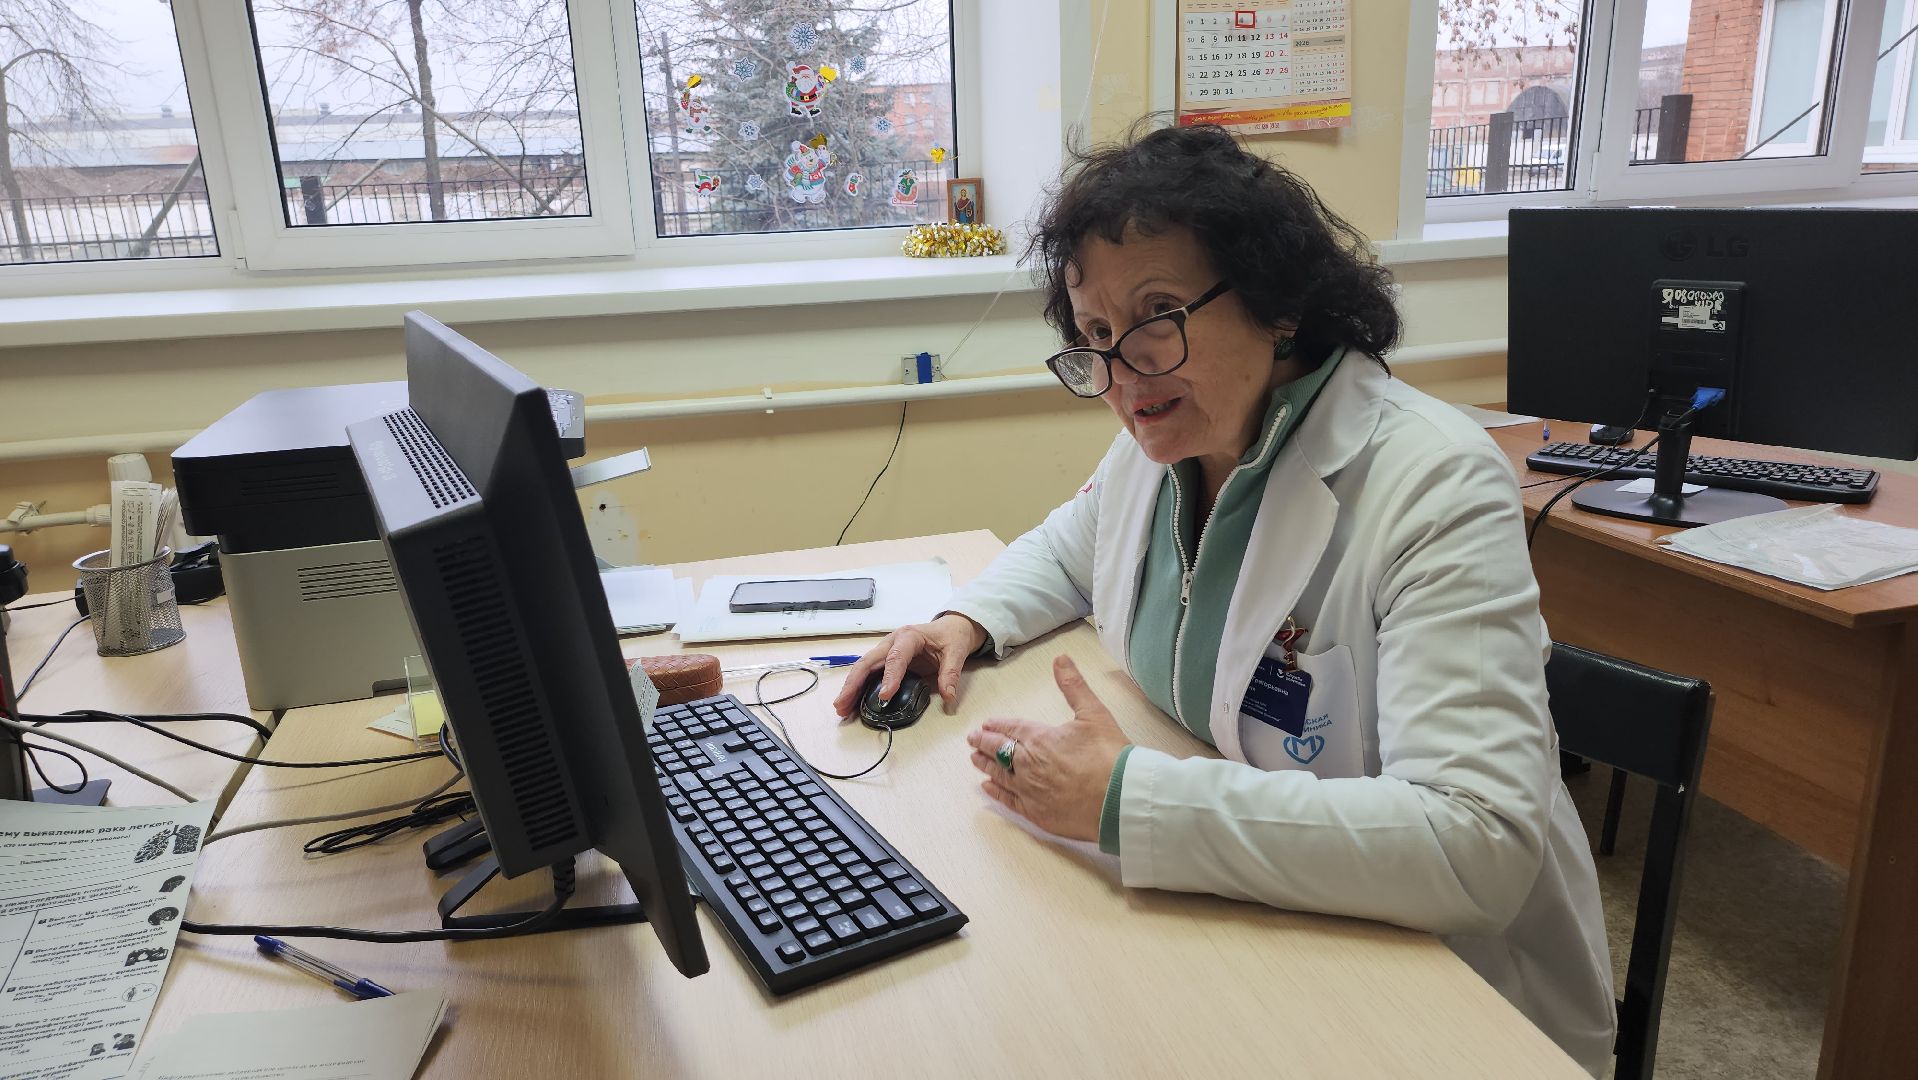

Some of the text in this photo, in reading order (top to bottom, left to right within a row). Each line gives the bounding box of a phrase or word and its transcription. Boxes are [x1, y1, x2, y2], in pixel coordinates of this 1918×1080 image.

[1237, 34, 1247, 42] 11
[1250, 33, 1261, 41] 12
[1279, 32, 1288, 40] 14
[1211, 53, 1220, 61] 16
[1251, 51, 1261, 59] 19
[1264, 50, 1275, 58] 20
[1199, 71, 1209, 79] 22
[1212, 71, 1221, 79] 23
[1224, 70, 1234, 78] 24
[1237, 69, 1247, 77] 25
[1264, 67, 1275, 76] 27
[1199, 89, 1209, 97] 29
[1212, 88, 1221, 96] 30
[1224, 87, 1234, 96] 31
[97, 826, 126, 835] рака
[128, 820, 174, 831] легкого
